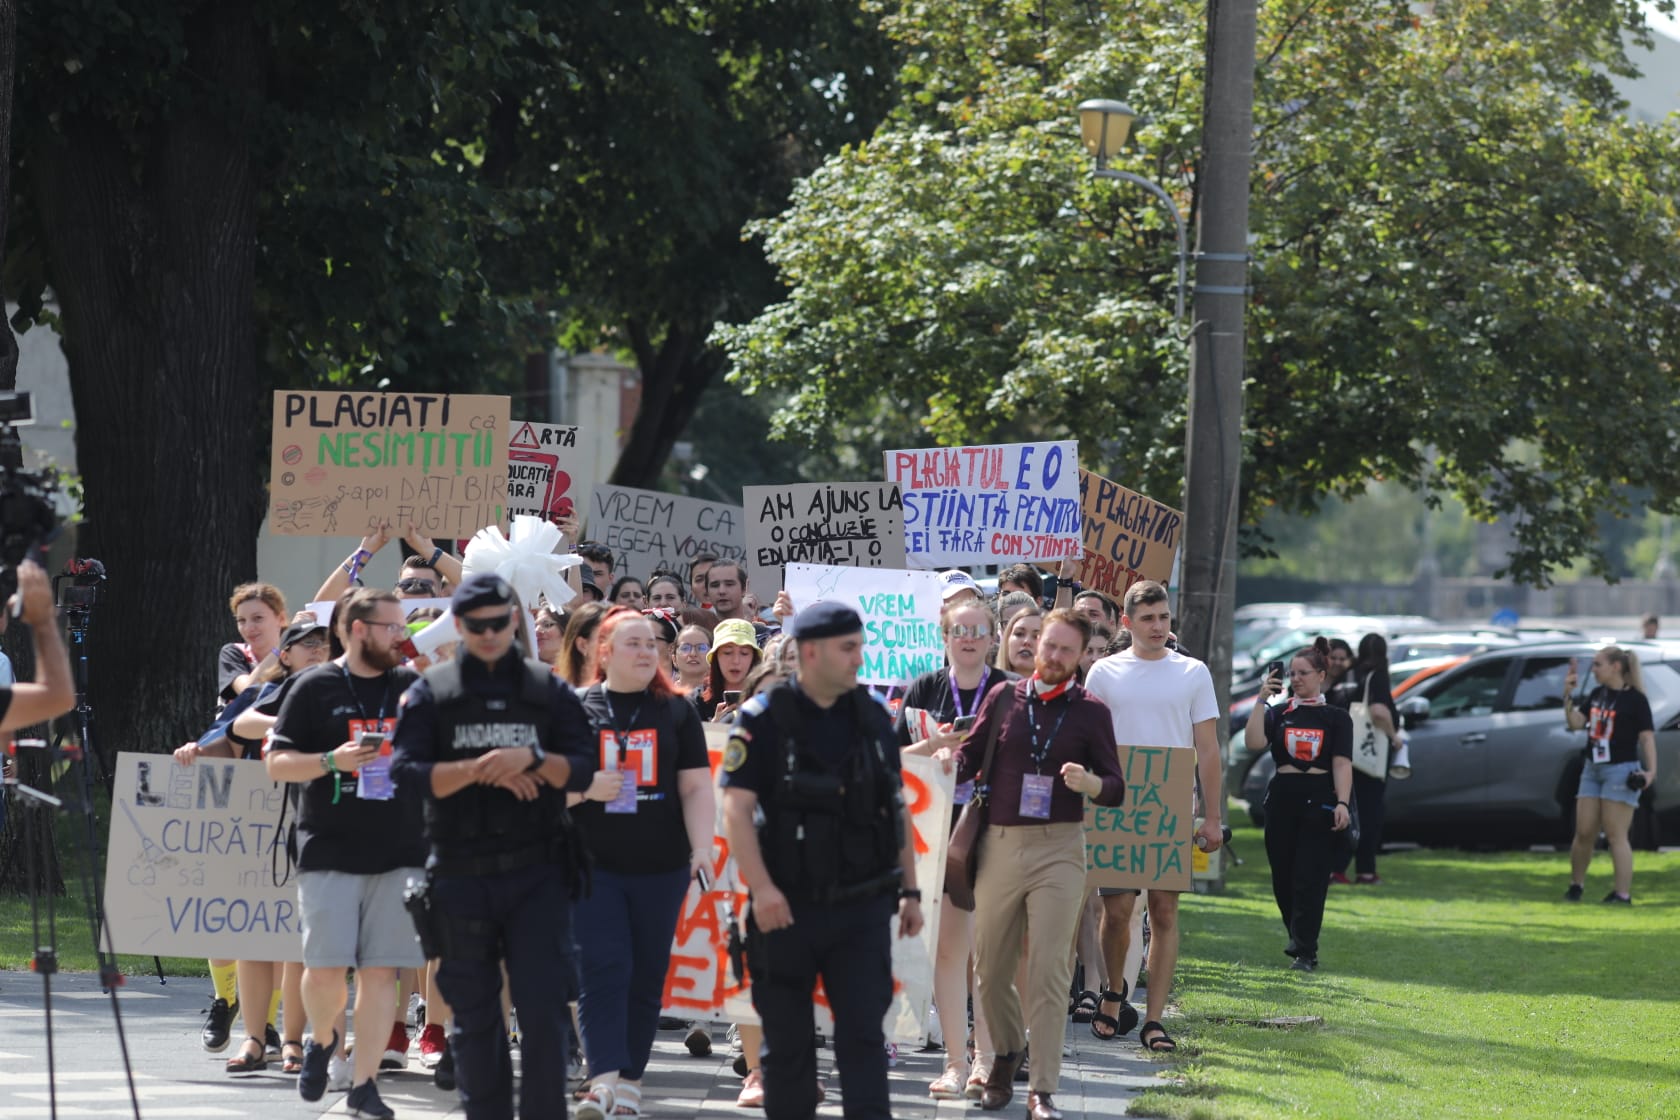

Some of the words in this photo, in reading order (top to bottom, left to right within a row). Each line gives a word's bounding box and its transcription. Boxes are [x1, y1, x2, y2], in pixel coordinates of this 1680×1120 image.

[285, 392, 450, 433] PLAGIAȚI
[317, 427, 494, 476] NESIMȚIȚII
[895, 448, 1010, 490] PLAGIATUL
[1014, 446, 1035, 490] E
[1041, 444, 1063, 491] O
[507, 480, 535, 498] ĂRĂ
[759, 491, 795, 524] AM
[878, 485, 904, 512] LA
[596, 490, 675, 528] VREM
[697, 506, 736, 536] CA
[1014, 494, 1082, 534] PENTRU
[1095, 479, 1180, 549] PLAGIATOR
[1110, 532, 1147, 570] CU
[858, 592, 915, 617] VREM
[857, 649, 942, 681] MÂNARE
[166, 896, 302, 935] VIGOAR
